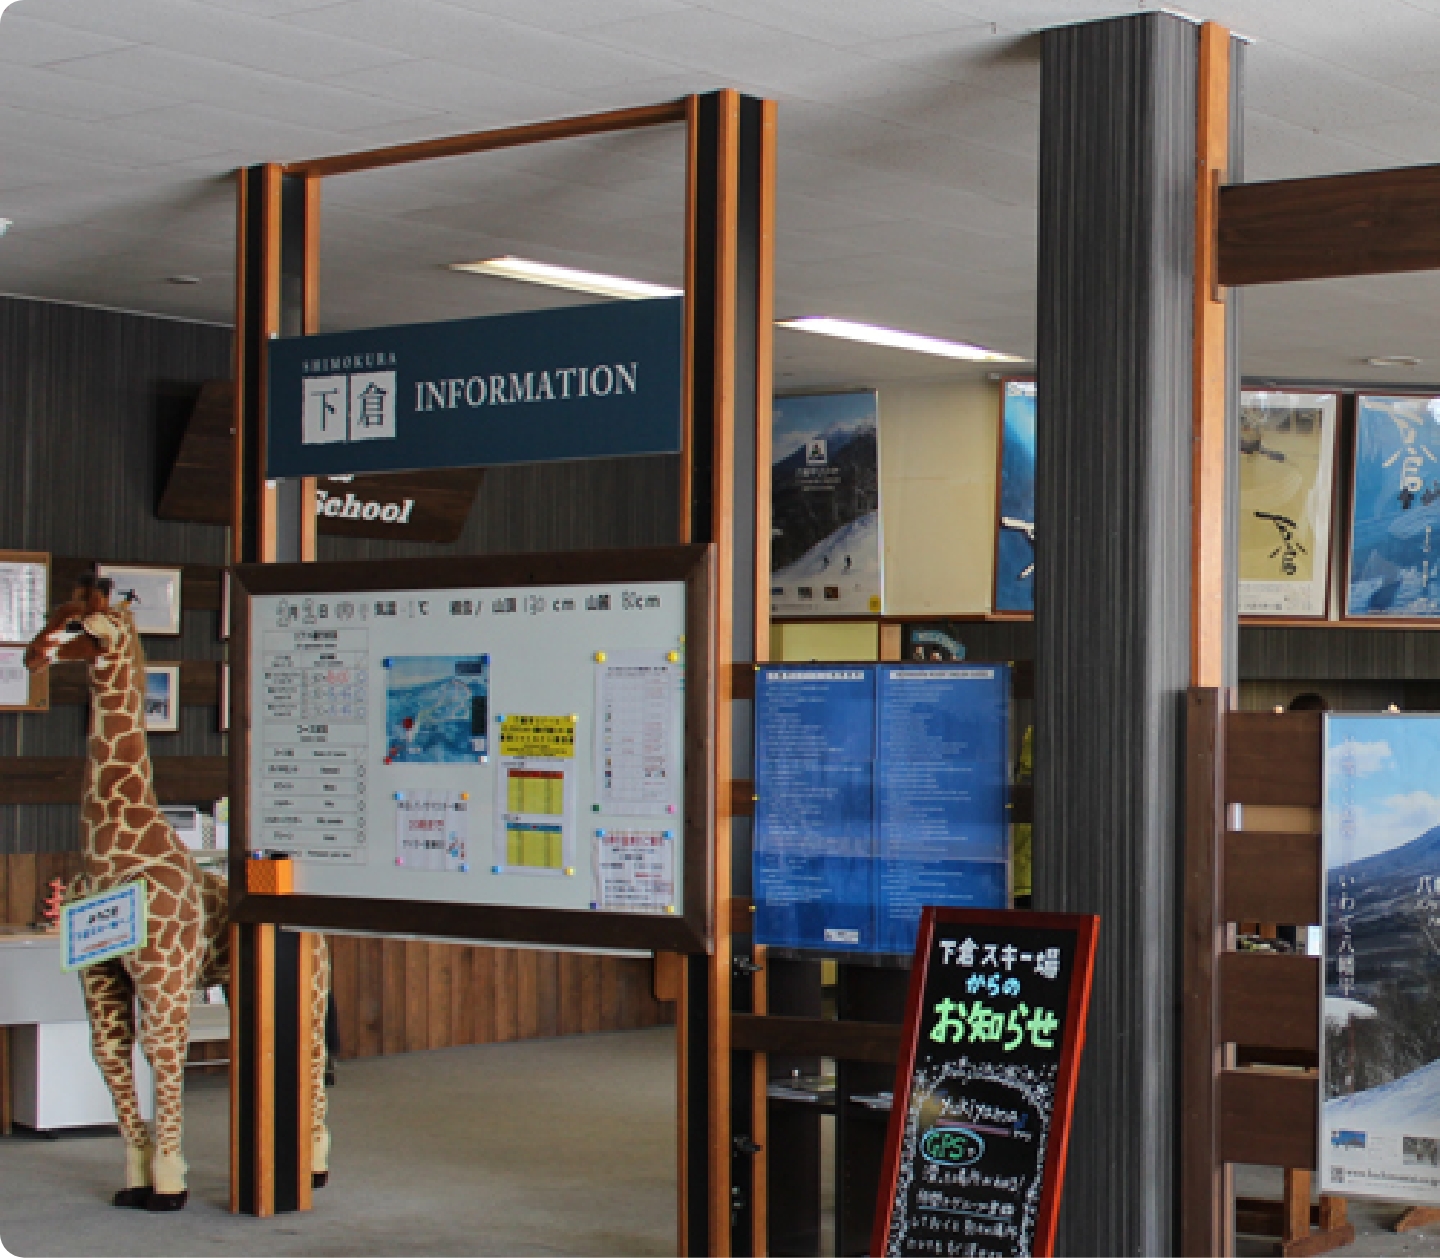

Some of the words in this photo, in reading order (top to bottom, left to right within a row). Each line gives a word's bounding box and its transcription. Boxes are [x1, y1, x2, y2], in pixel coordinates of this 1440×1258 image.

[302, 352, 397, 372] SHIMOKURA
[310, 381, 389, 432] 下倉
[414, 362, 639, 412] INFORMATION
[939, 937, 1060, 979] 下倉スキー場
[965, 972, 1021, 997] からの
[929, 998, 1060, 1050] お知らせ
